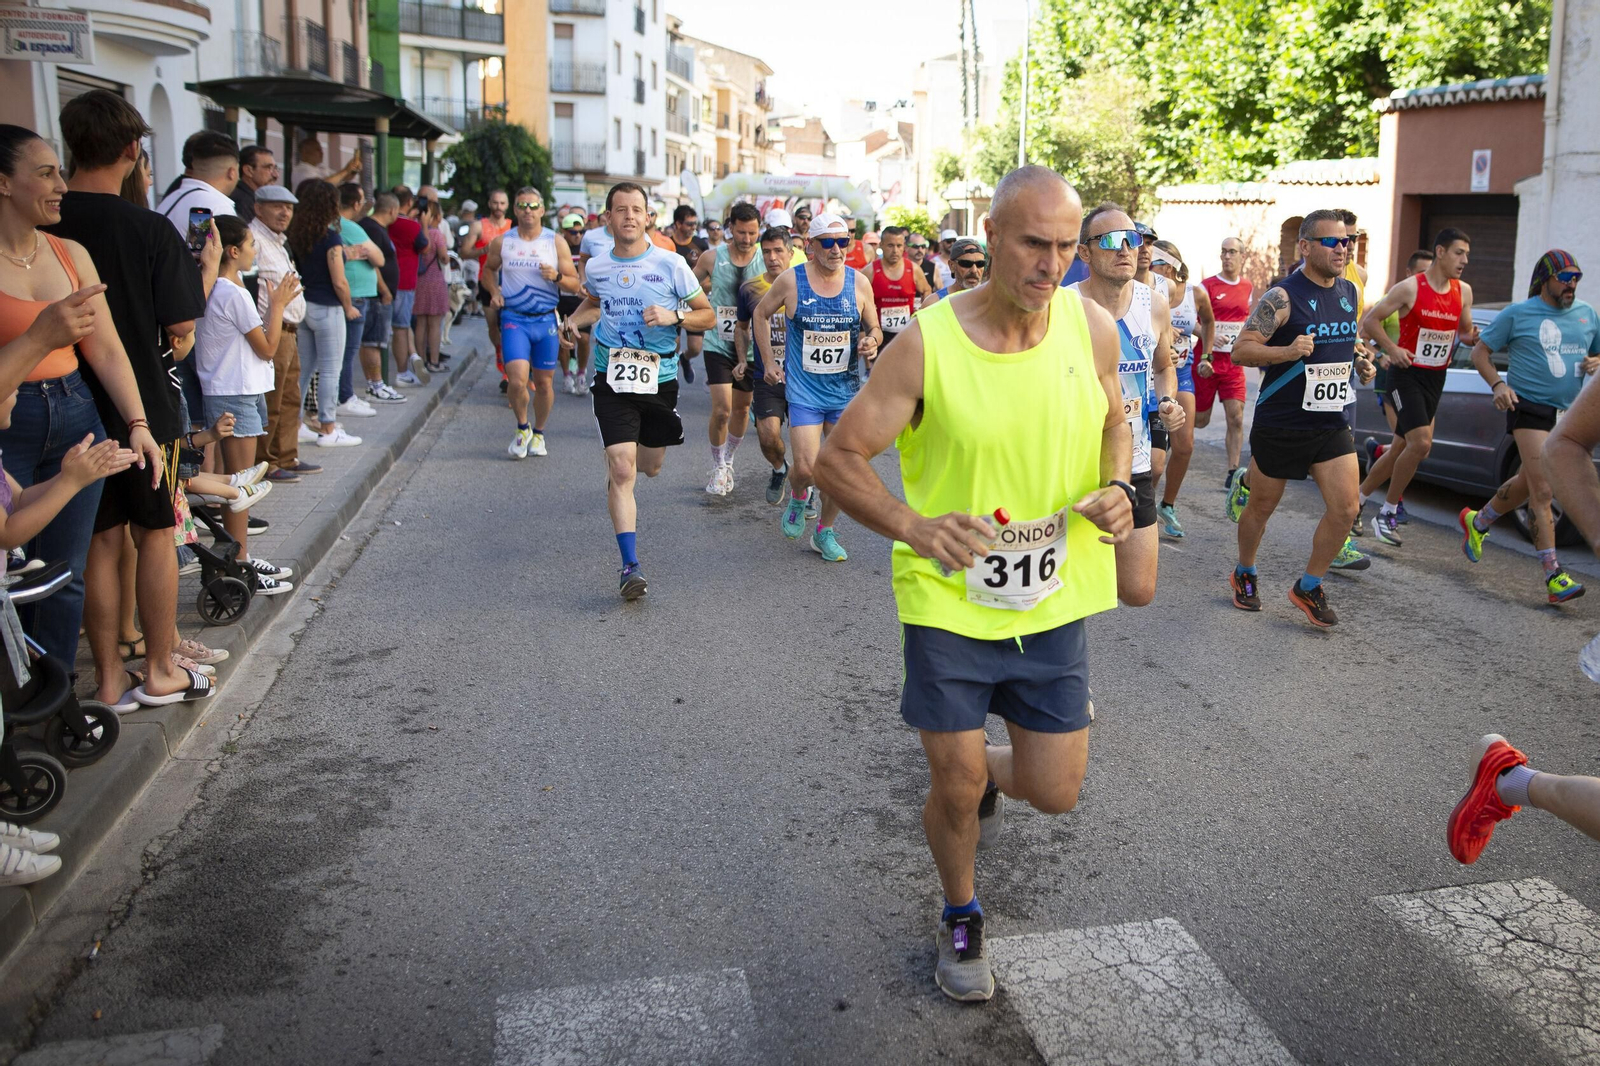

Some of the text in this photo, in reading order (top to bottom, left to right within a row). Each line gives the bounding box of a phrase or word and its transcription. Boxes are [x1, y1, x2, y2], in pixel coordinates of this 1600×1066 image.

[18, 31, 67, 41] AUTOESCUELA
[612, 297, 643, 306] PINTURAS
[802, 316, 825, 324] PAZITO
[831, 316, 854, 324] PAZITO
[886, 316, 907, 328] 374
[1306, 320, 1357, 336] CAZOO
[813, 335, 843, 344] FONDO
[617, 351, 651, 363] FONDO
[810, 348, 845, 365] 467
[1422, 343, 1449, 359] 875
[614, 364, 651, 384] 236
[1318, 367, 1347, 377] FONDO
[1314, 382, 1348, 401] 605
[1001, 523, 1055, 544] ONDO
[983, 547, 1056, 589] 316
